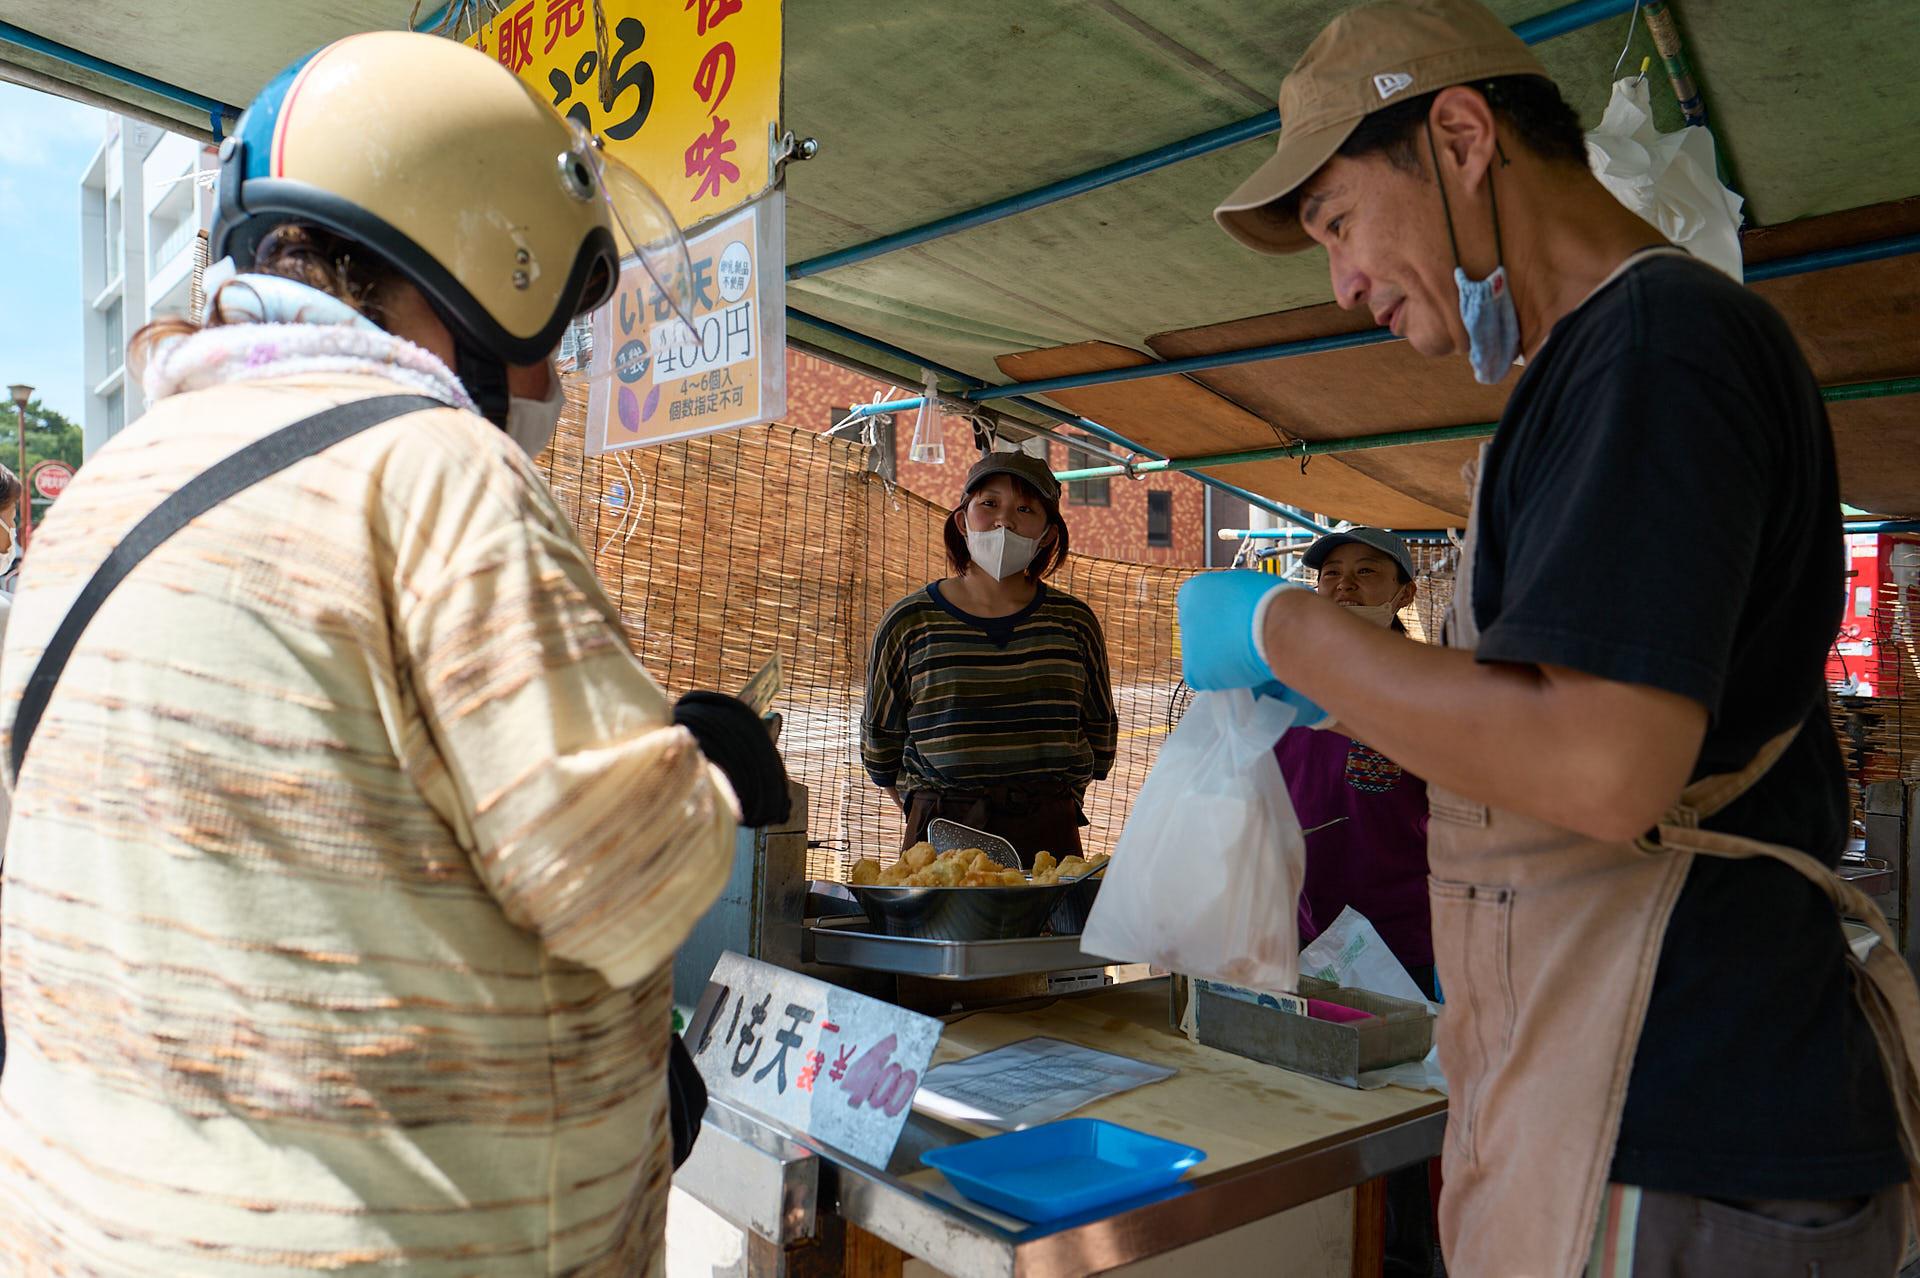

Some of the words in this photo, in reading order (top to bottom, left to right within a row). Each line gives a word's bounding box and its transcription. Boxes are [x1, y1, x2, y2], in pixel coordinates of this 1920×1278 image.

[722, 275, 745, 290] 不使用
[656, 301, 750, 373] 400円
[669, 385, 744, 421] 個数指定不可
[698, 985, 816, 1096] いも天
